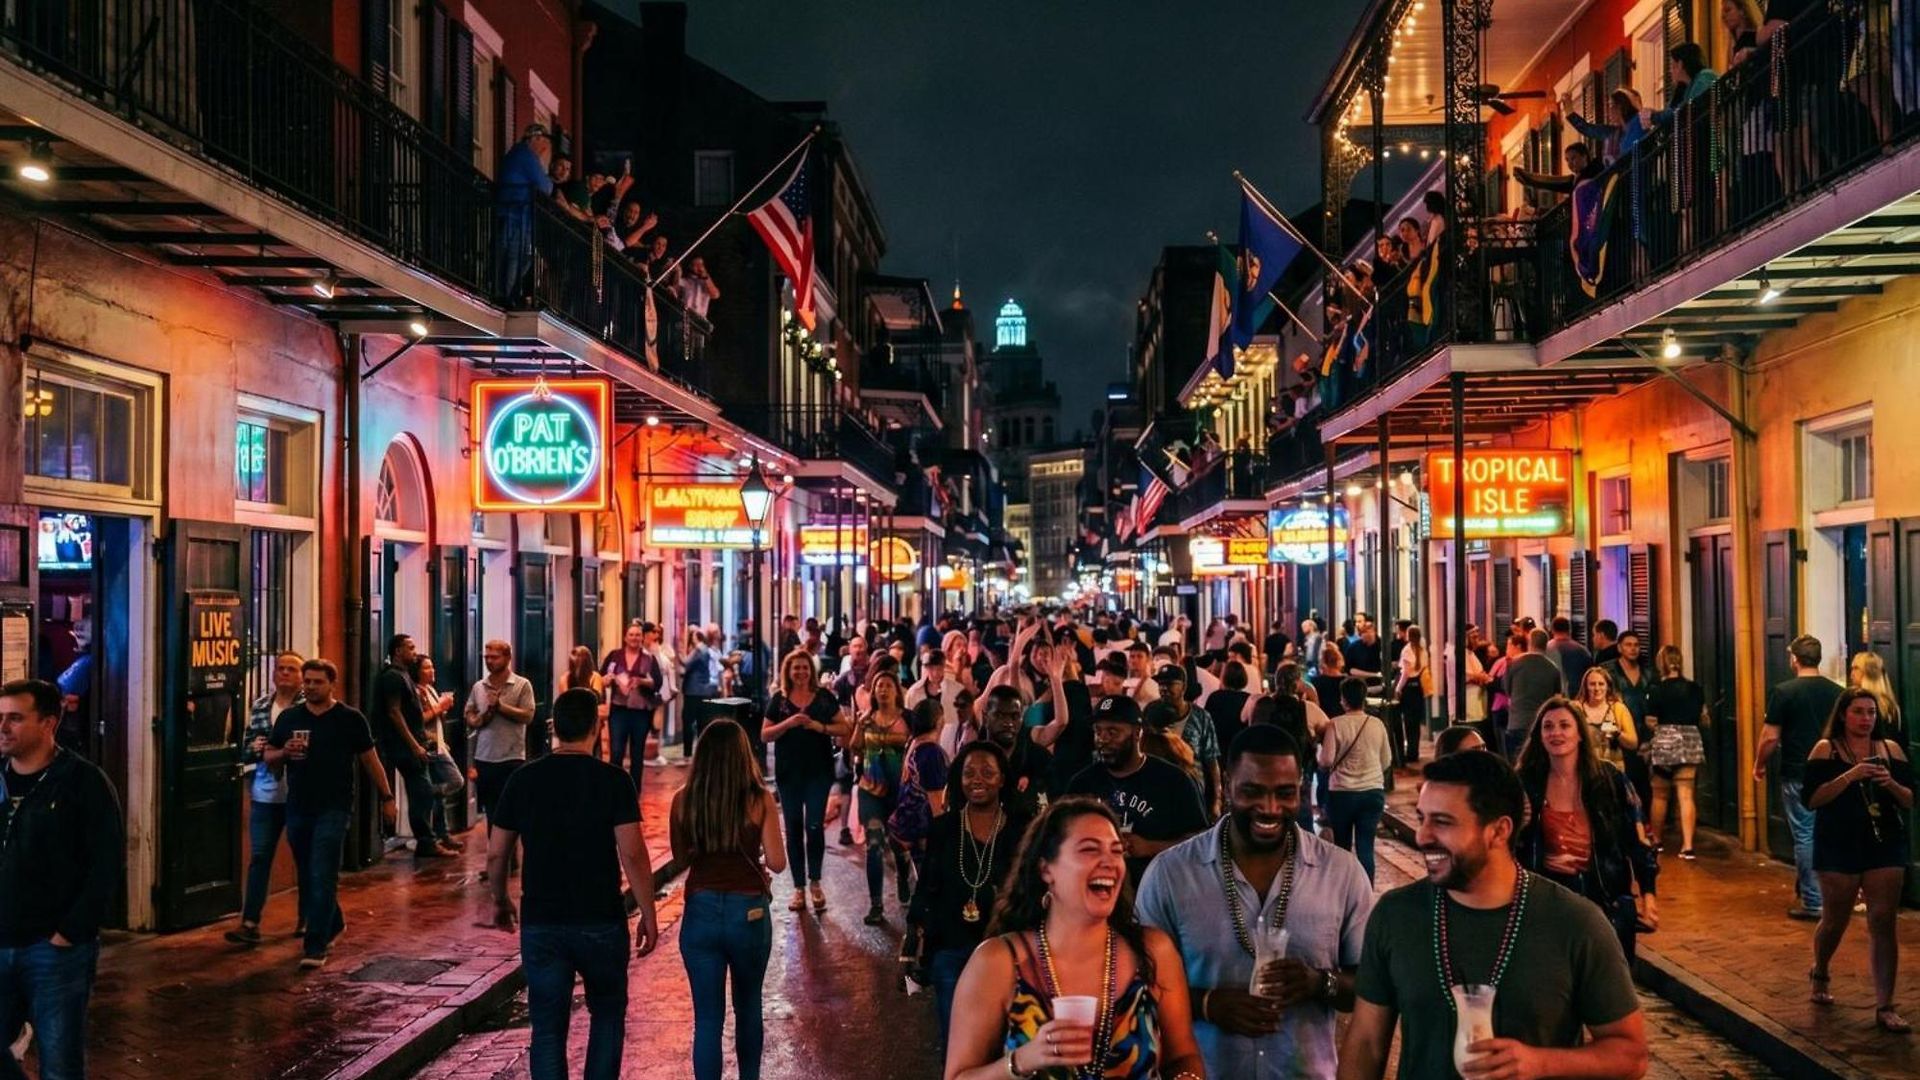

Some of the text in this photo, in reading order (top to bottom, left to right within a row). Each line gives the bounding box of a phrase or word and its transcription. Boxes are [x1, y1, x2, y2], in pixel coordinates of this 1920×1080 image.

[513, 412, 571, 443] PAT
[494, 440, 589, 475] O'BRIEN'S
[1437, 457, 1567, 484] TROPICAL
[1473, 487, 1531, 514] ISLE
[200, 611, 232, 638] LIVE
[192, 639, 240, 668] MUSIC
